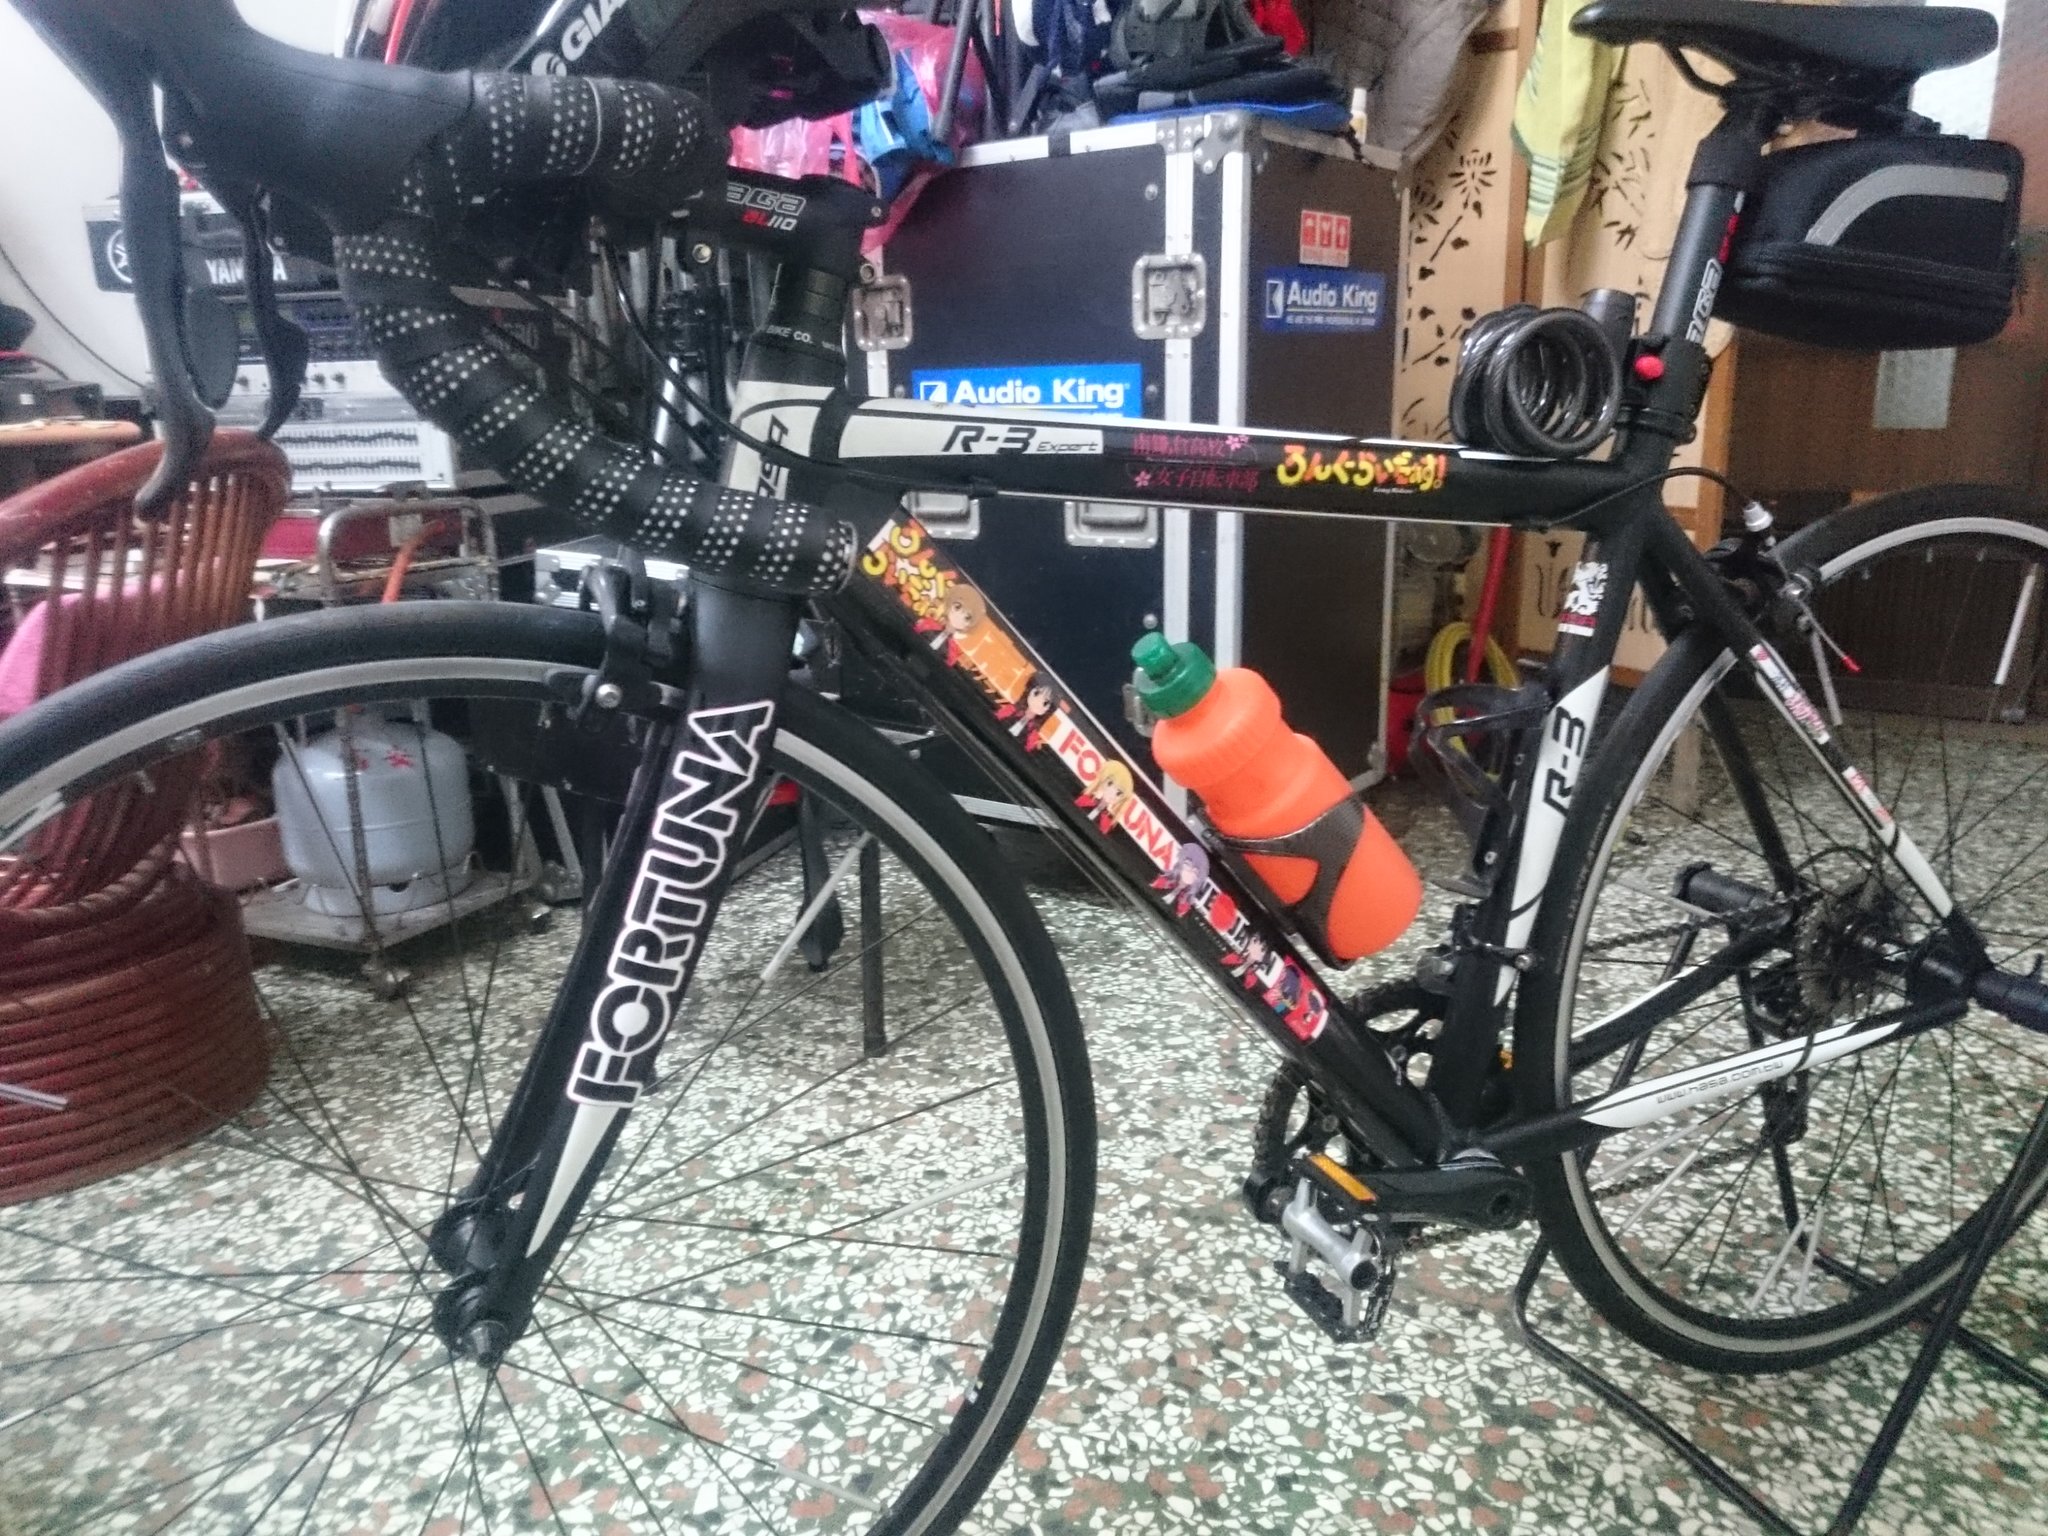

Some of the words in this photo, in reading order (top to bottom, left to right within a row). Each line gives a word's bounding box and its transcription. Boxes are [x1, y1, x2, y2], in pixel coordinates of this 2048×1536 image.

[205, 257, 288, 285] YAMA
[1286, 280, 1338, 307] Audio
[1341, 284, 1378, 314] King
[951, 379, 1041, 405] Audio
[1052, 378, 1124, 409] King
[941, 424, 1037, 454] R-3
[1036, 441, 1099, 455] Expert
[1542, 705, 1586, 818] R-3
[1058, 728, 1175, 871] FOUNA
[566, 700, 775, 1109] FORTUNA
